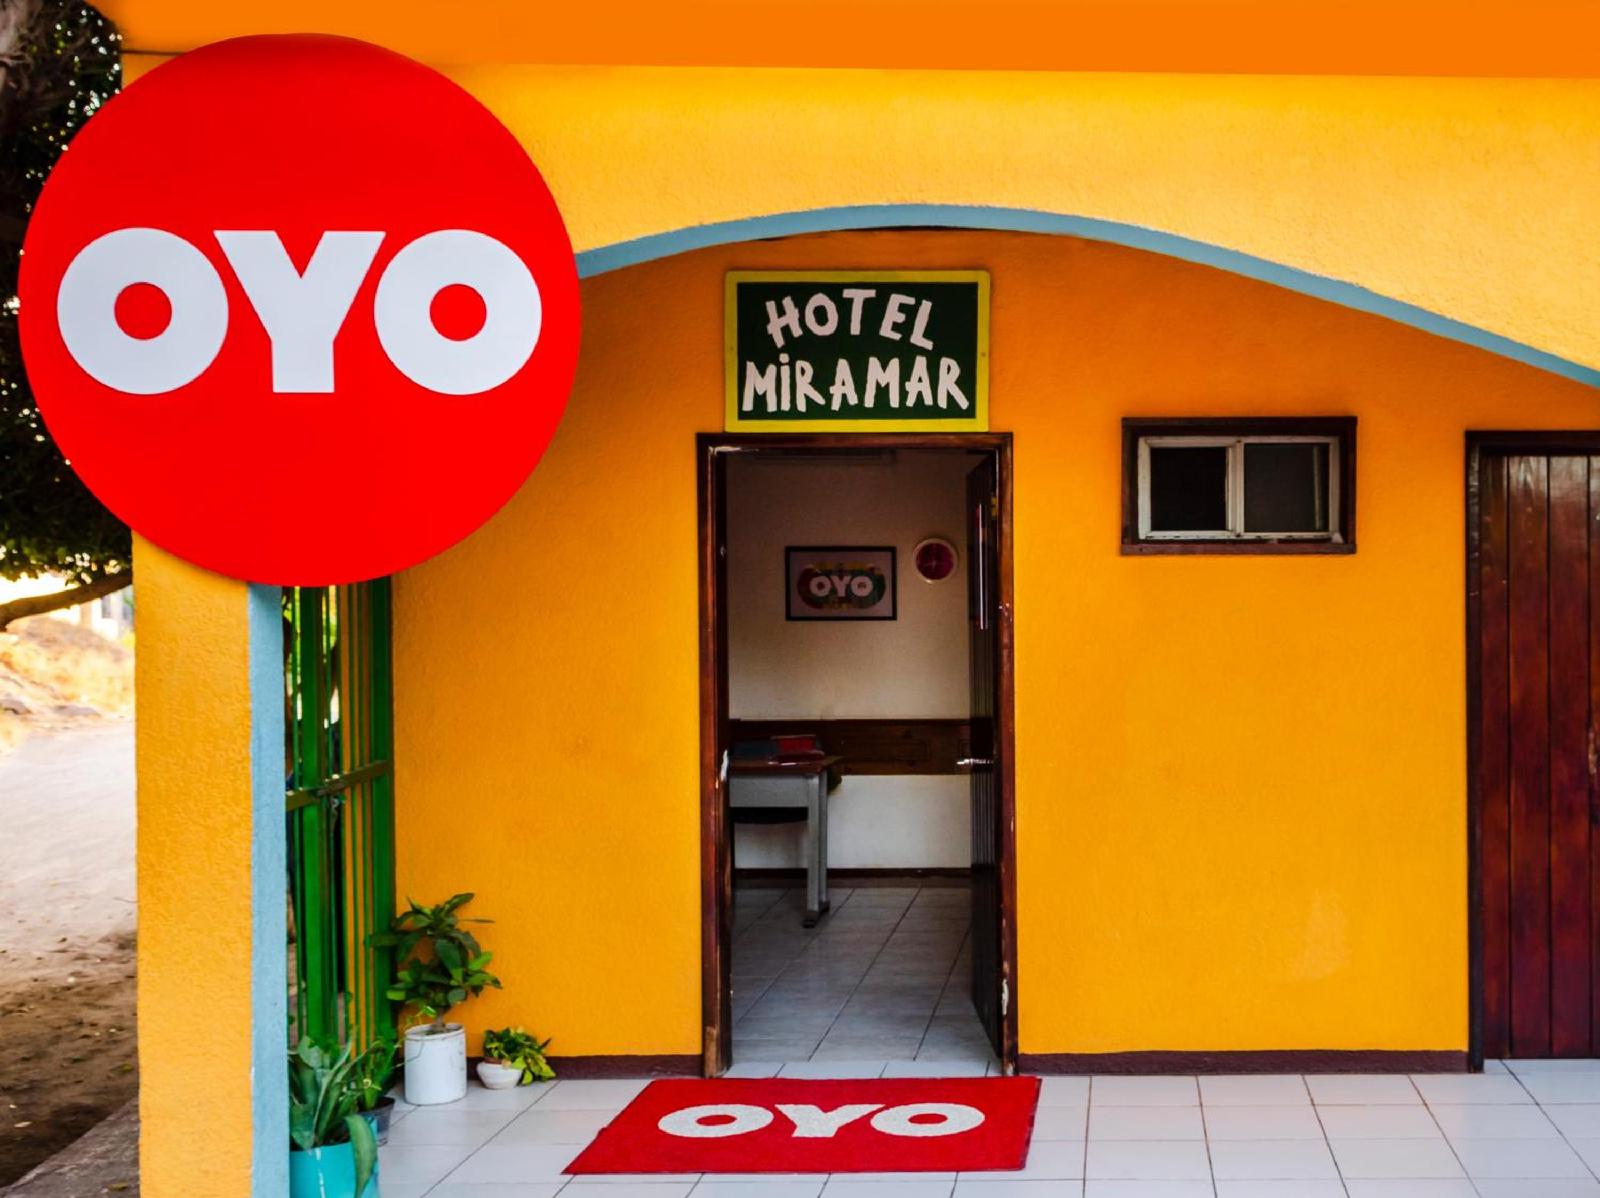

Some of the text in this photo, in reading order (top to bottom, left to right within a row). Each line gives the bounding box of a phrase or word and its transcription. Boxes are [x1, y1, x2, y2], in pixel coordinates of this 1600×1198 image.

[57, 227, 543, 396] OYO
[765, 288, 934, 350] HOTEL
[809, 575, 873, 597] OYO
[657, 1102, 985, 1138] OYO
